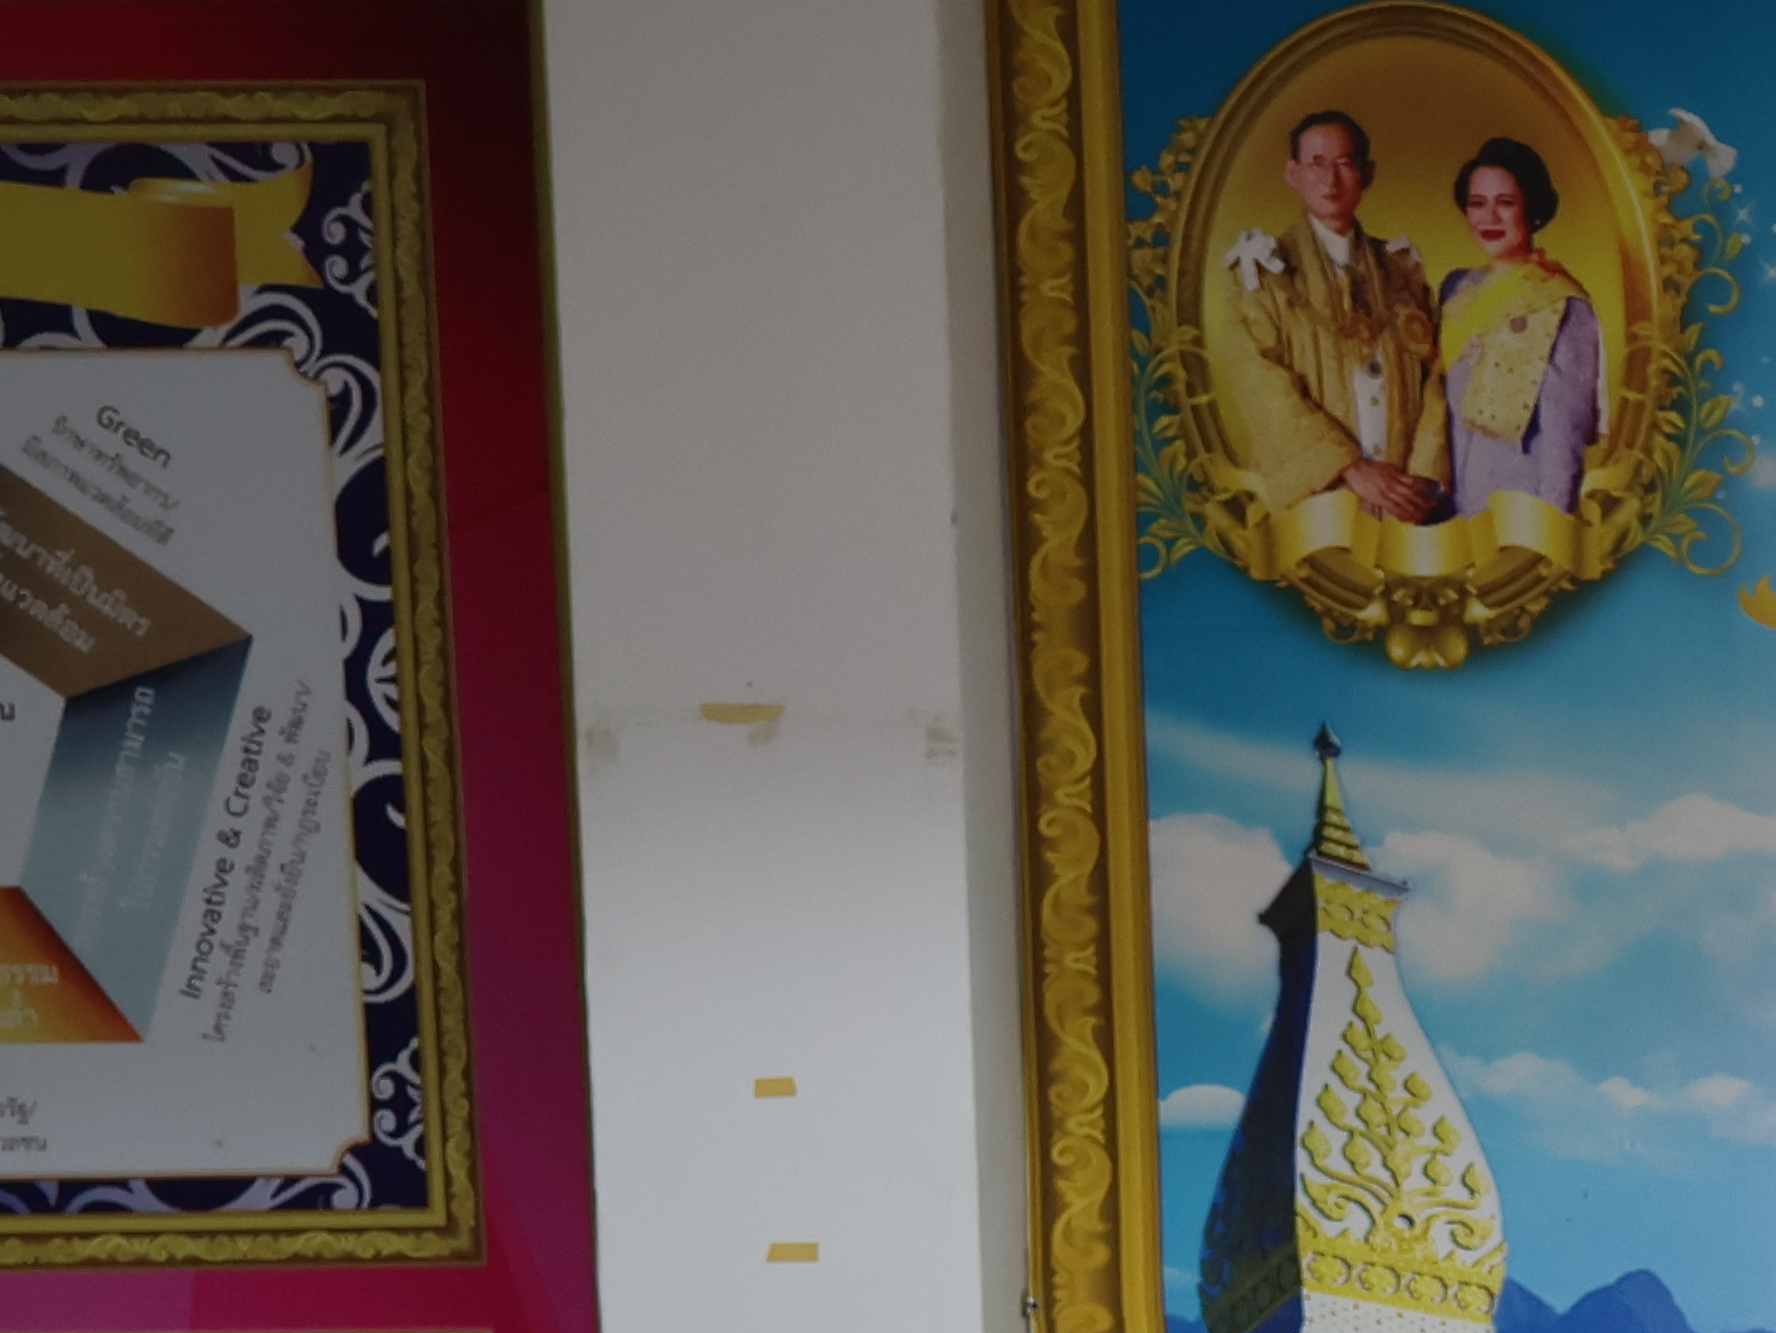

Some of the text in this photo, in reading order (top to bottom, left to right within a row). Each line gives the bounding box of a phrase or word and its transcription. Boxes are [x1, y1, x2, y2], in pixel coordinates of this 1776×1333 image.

[95, 405, 172, 467] Green
[181, 706, 272, 1002] Innovative & Creative
